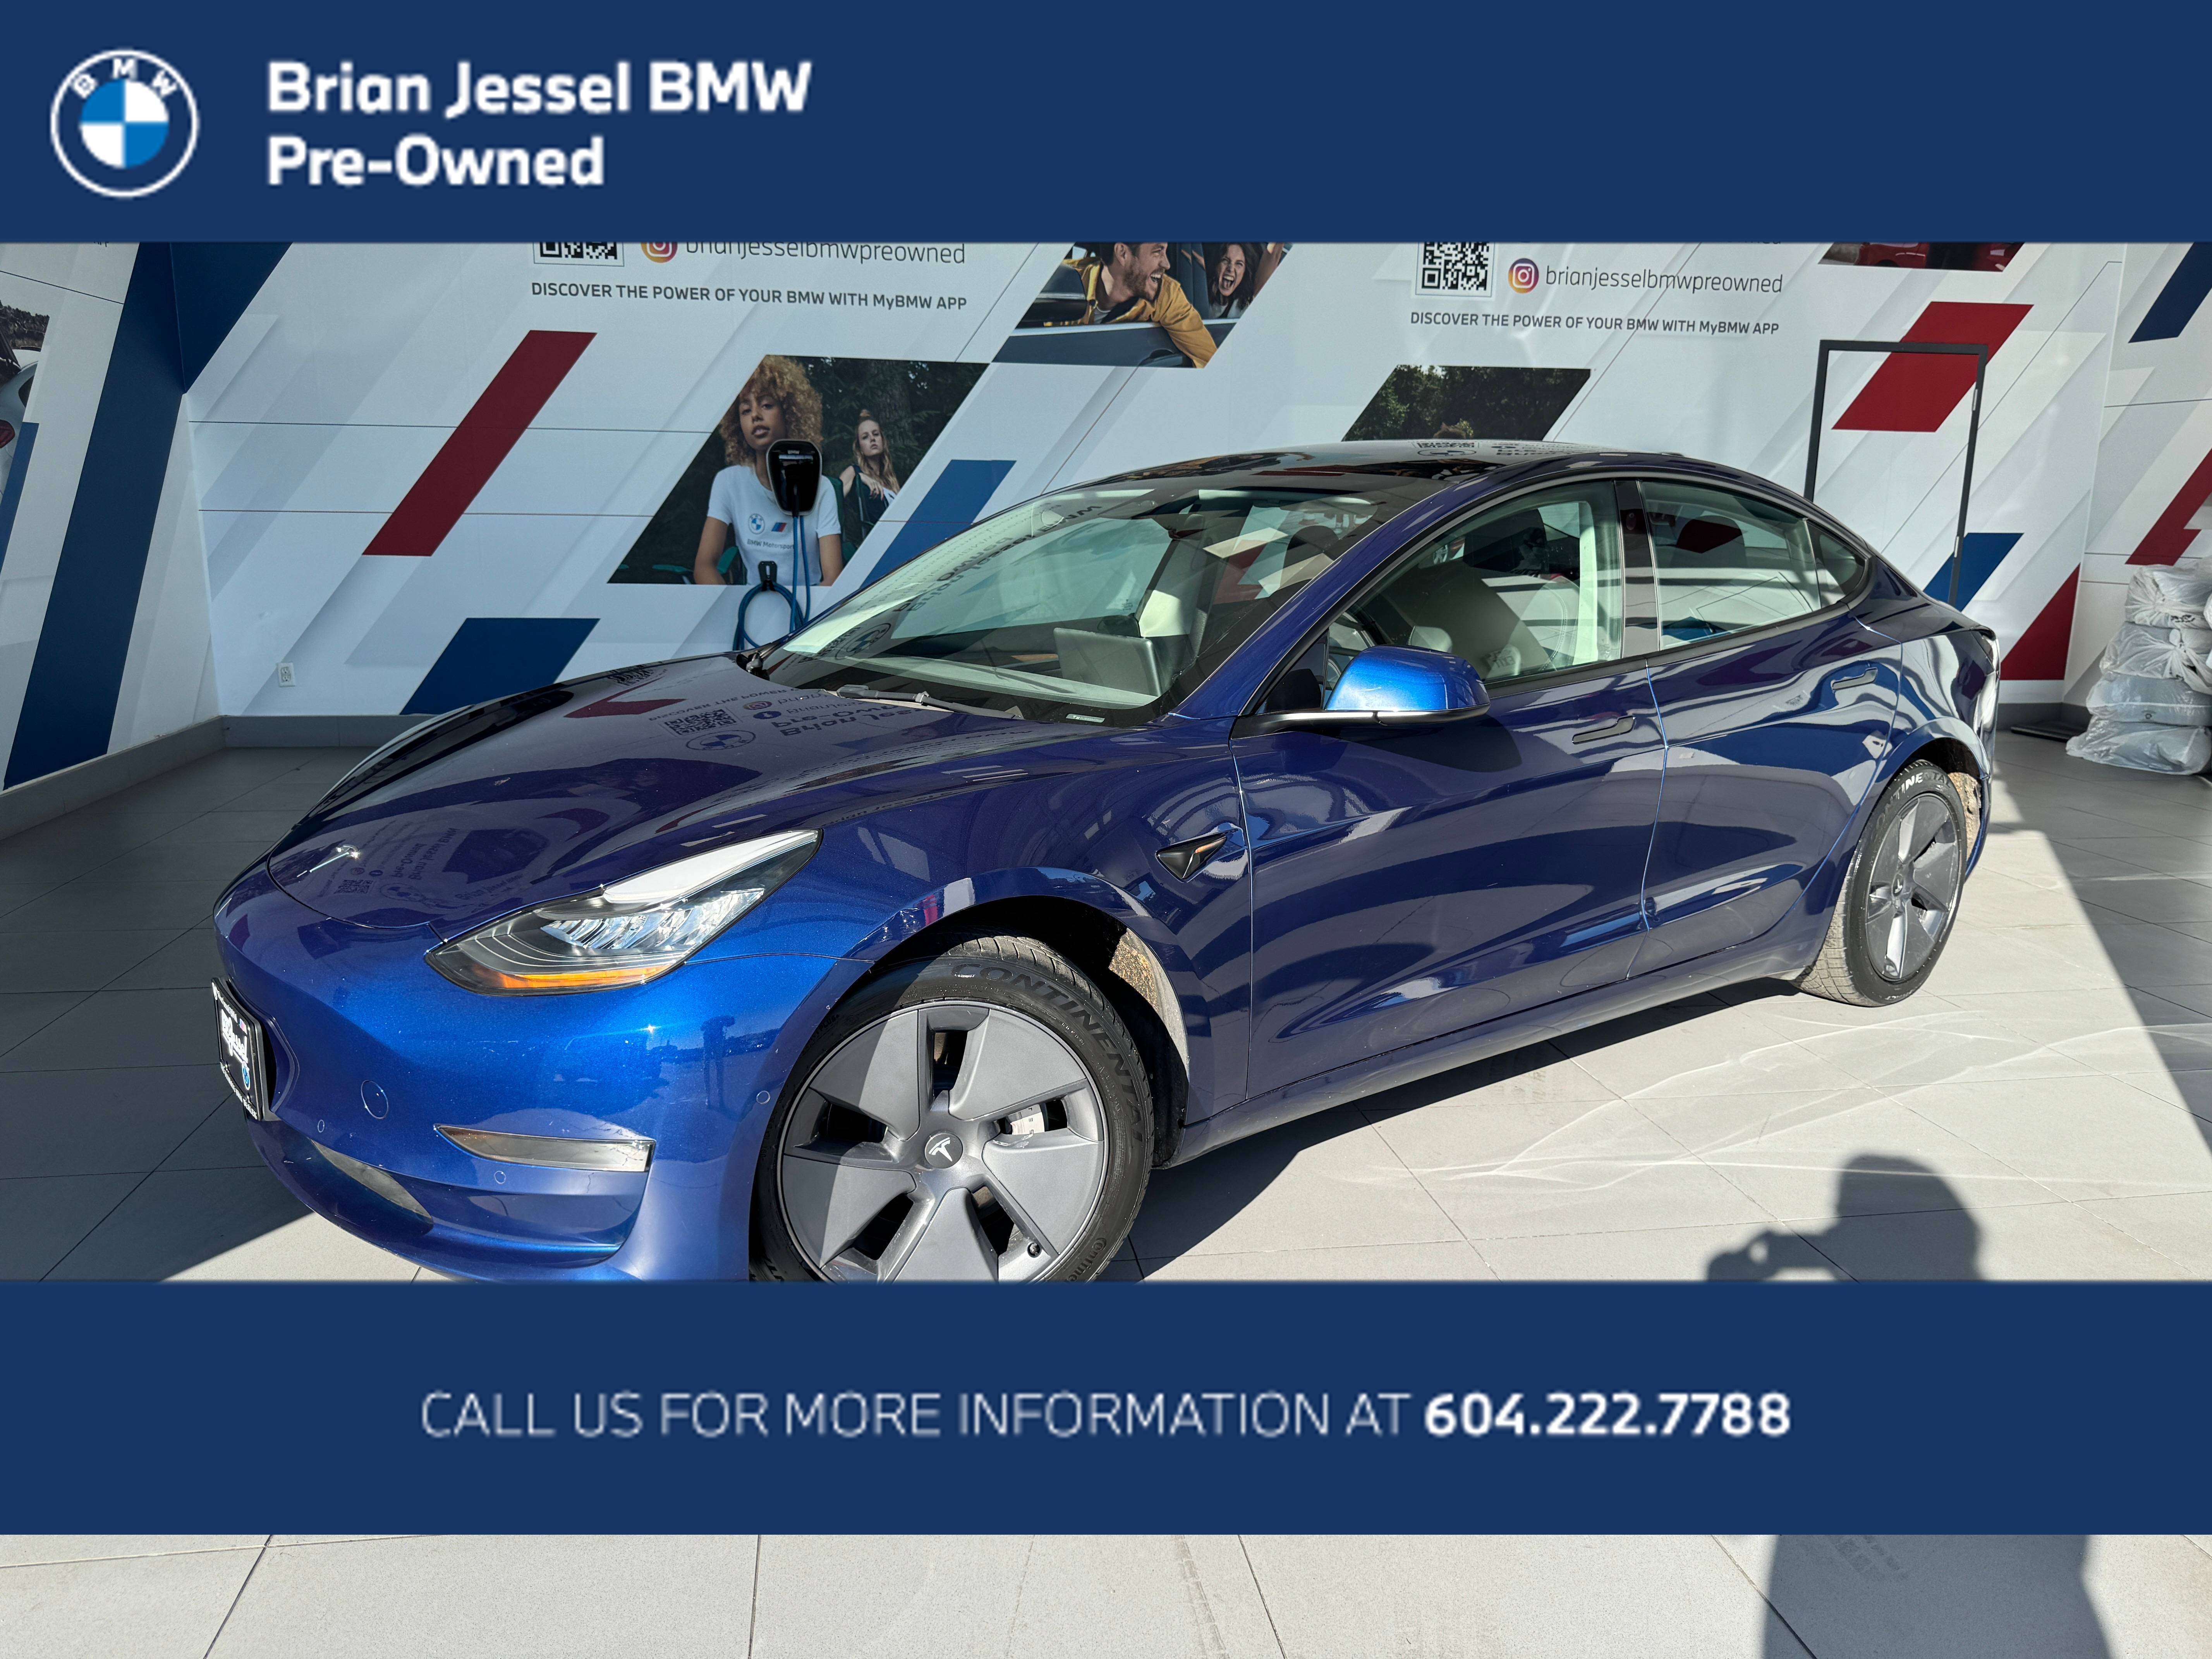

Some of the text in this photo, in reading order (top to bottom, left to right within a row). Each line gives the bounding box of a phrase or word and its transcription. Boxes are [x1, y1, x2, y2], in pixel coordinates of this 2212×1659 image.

[1546, 266, 1783, 294] brianjesselbmwpreowned
[532, 283, 967, 310] DISCOVER THE POWER OF YOUR BMW WITH MyBMW APP
[1411, 312, 1779, 335] DISCOVER THE POWER OF YOUR BMW WITH MyBMW APP
[762, 541, 793, 550] Motorspor
[951, 963, 1143, 1142] CONTINENTAL
